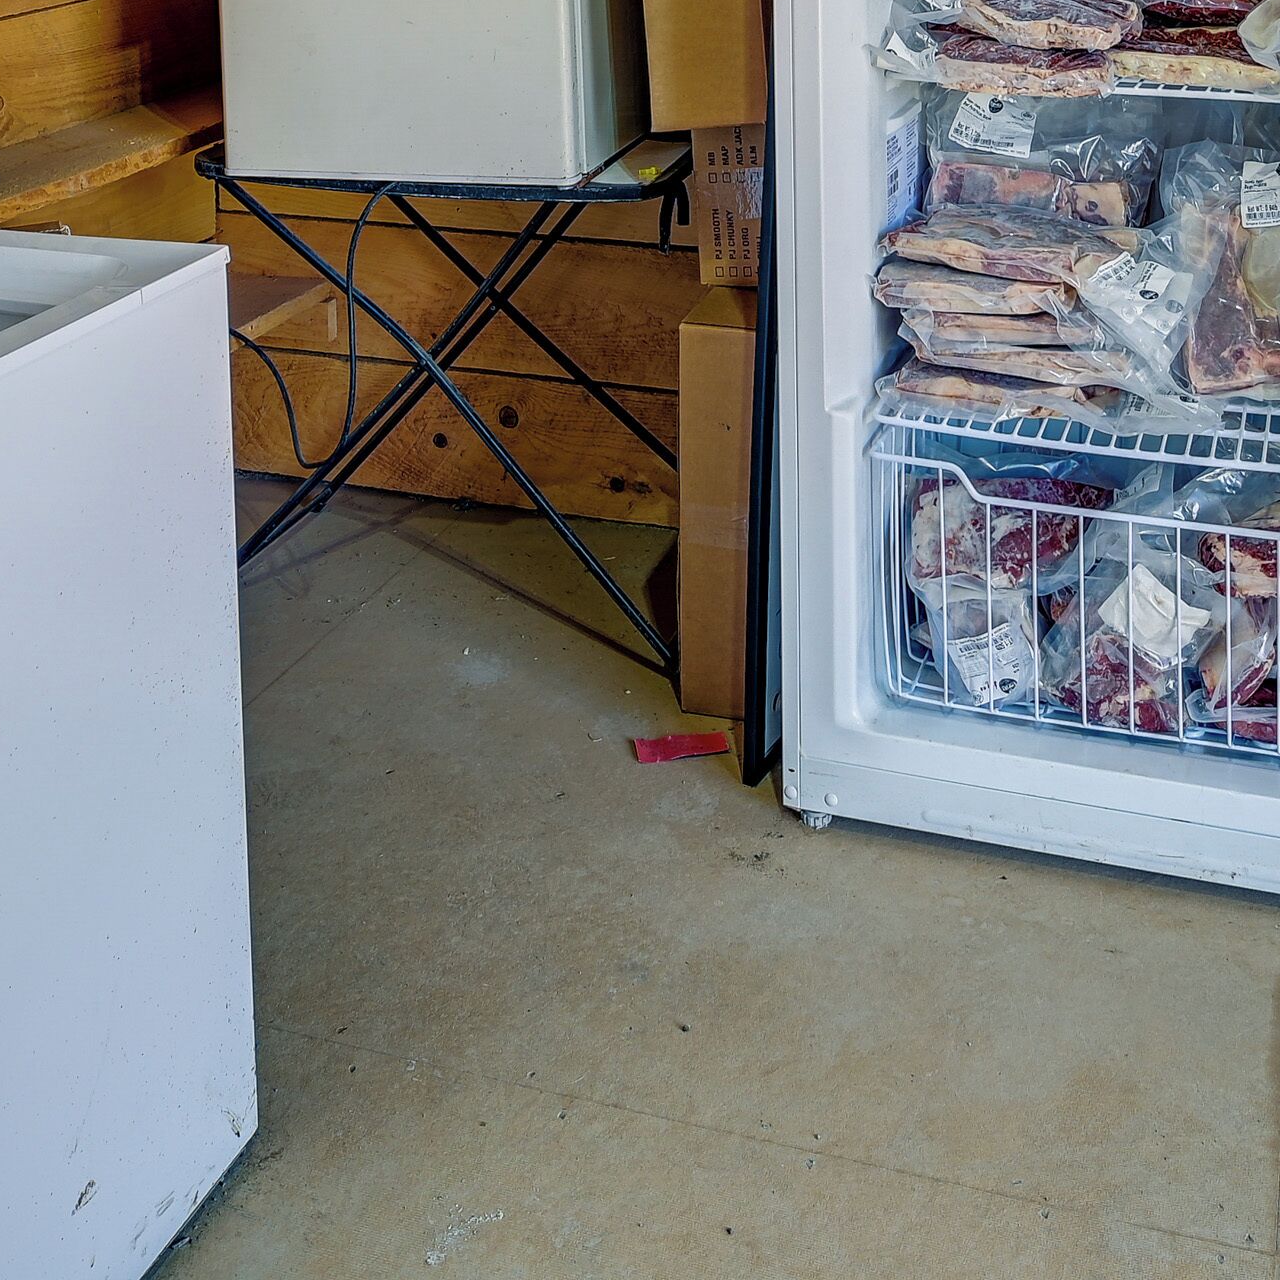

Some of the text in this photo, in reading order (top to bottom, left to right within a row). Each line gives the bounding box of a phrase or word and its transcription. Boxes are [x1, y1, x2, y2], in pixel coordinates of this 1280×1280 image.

[708, 152, 715, 166] MB
[721, 146, 730, 166] MAP
[735, 147, 744, 166] ADK
[750, 146, 758, 166] ALM
[712, 209, 722, 260] PJ SMOOTH
[726, 209, 736, 260] PJ CHUNKY
[743, 249, 750, 260] PJ
